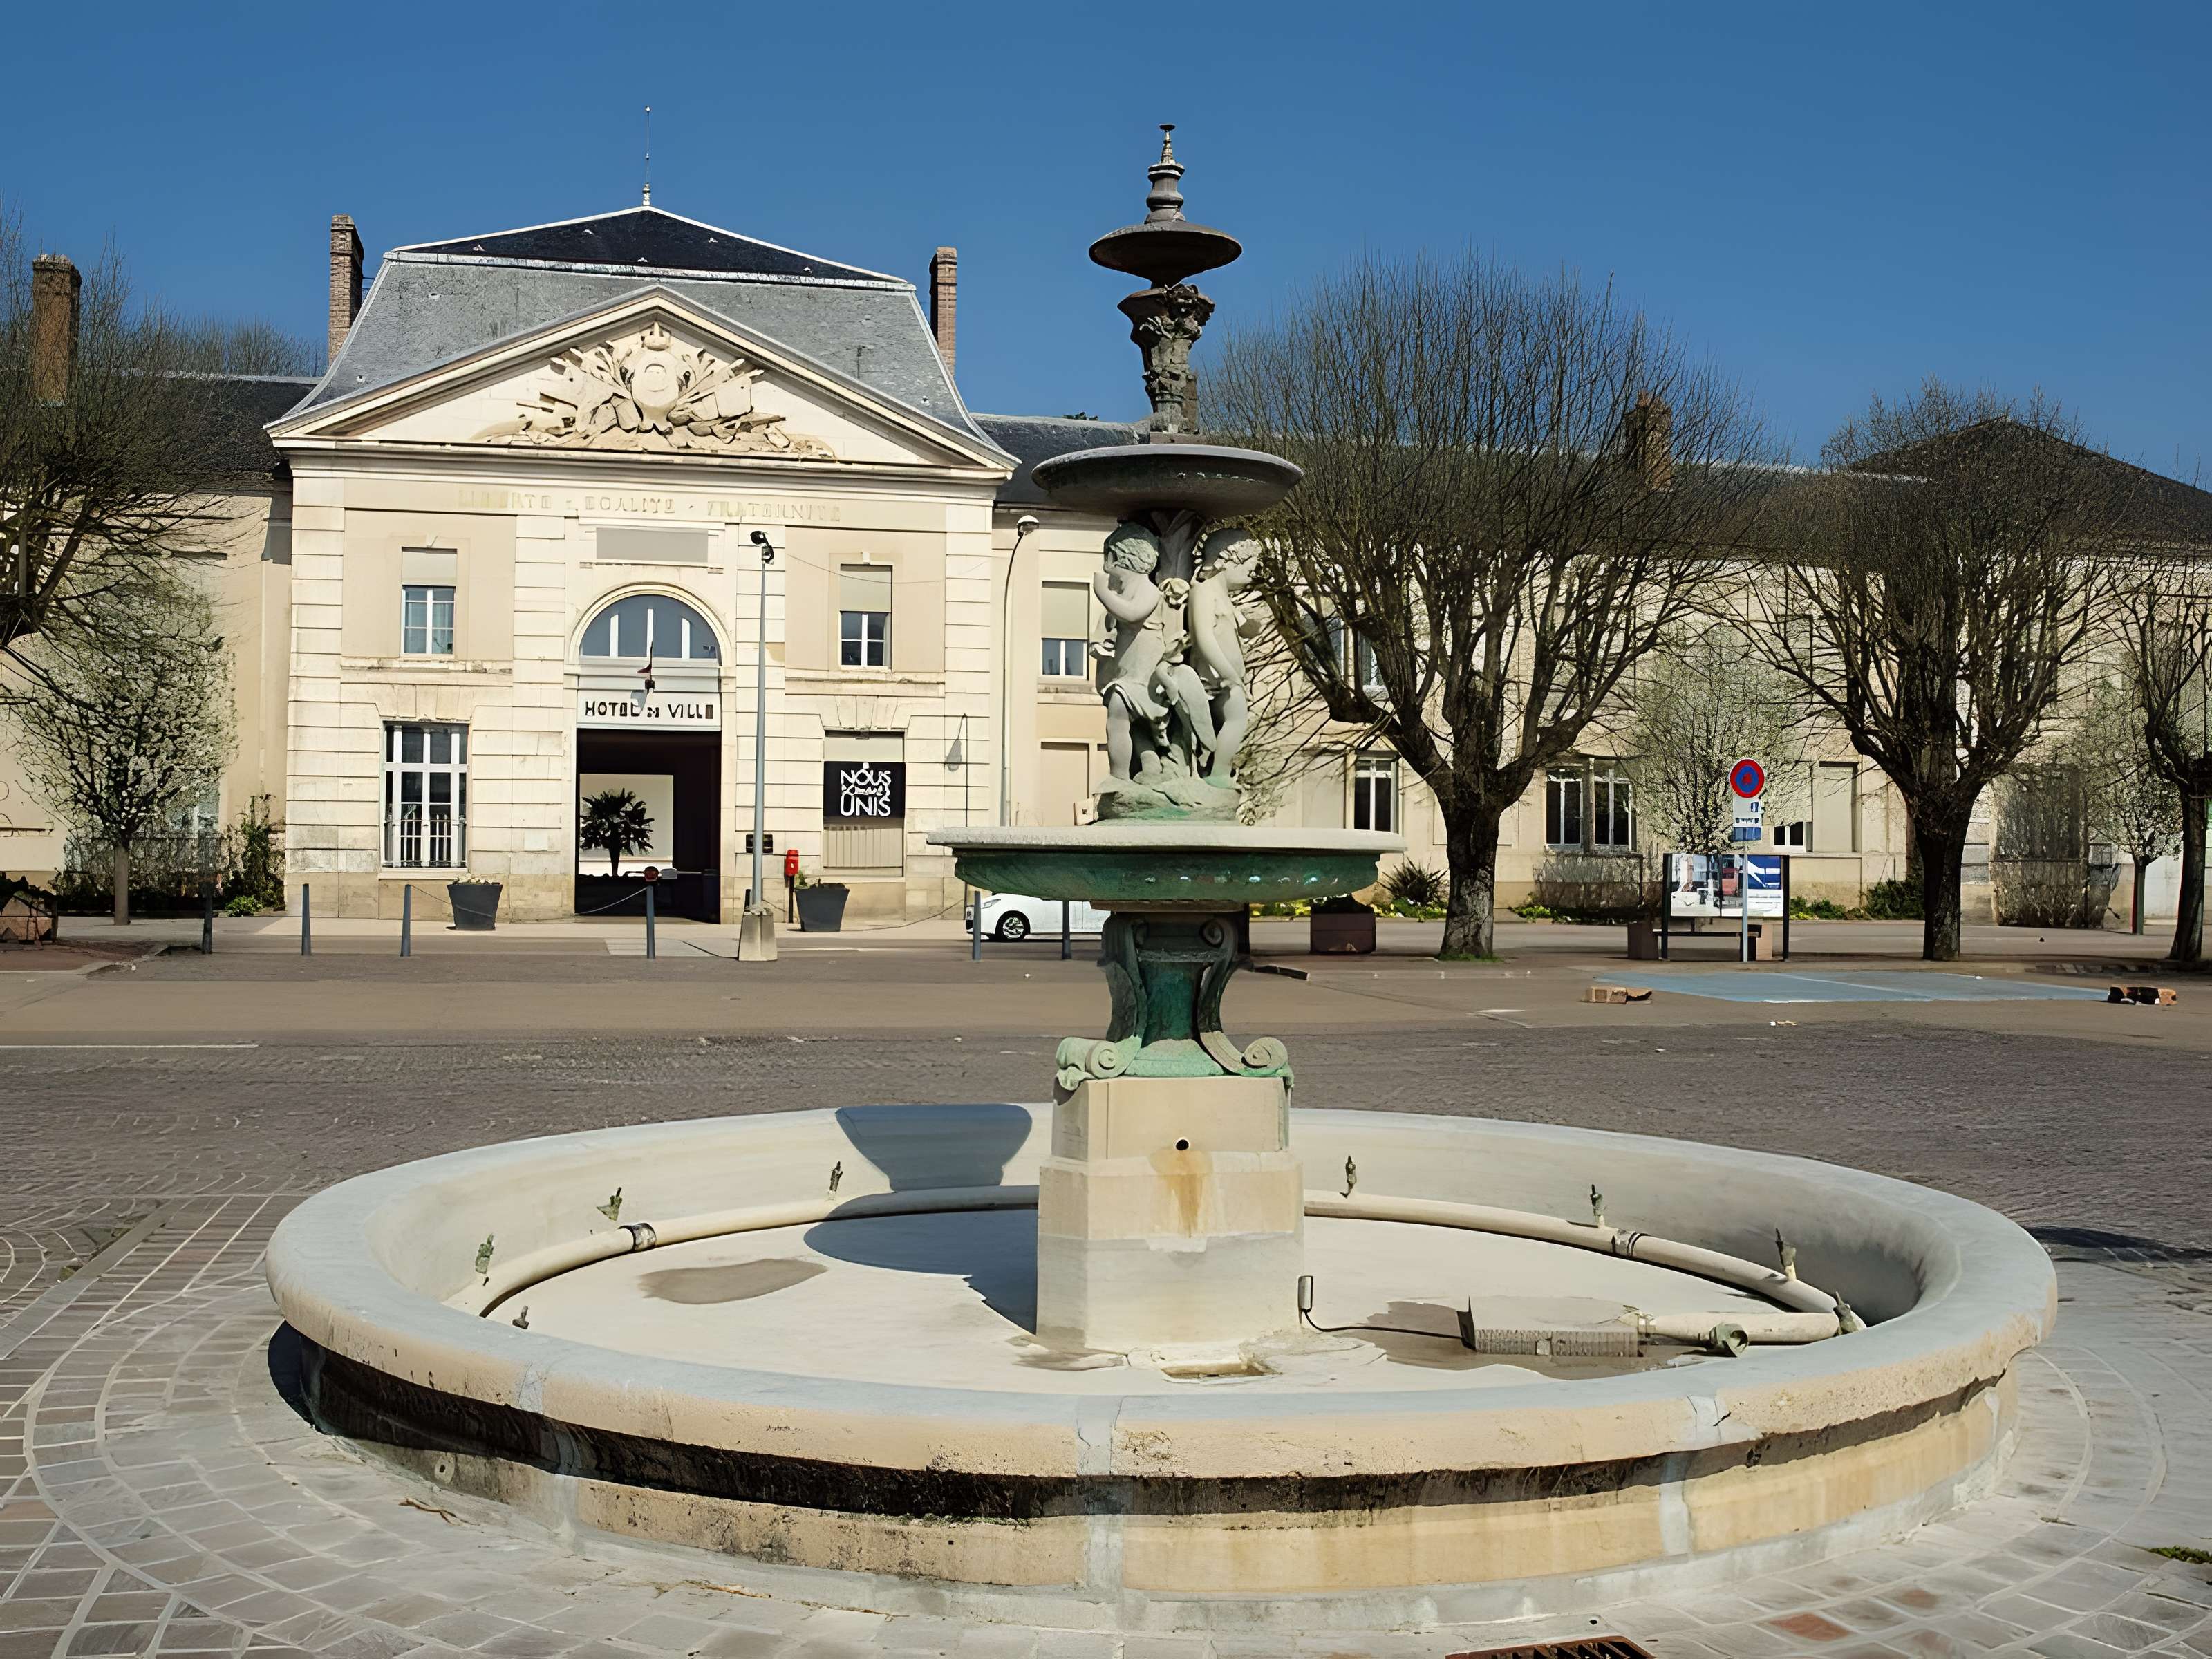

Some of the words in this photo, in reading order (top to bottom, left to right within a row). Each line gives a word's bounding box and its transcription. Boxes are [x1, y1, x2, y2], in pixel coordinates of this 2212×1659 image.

[458, 489, 552, 509] LIRTE
[841, 769, 892, 786] NOUS
[840, 794, 891, 816] UNIS
